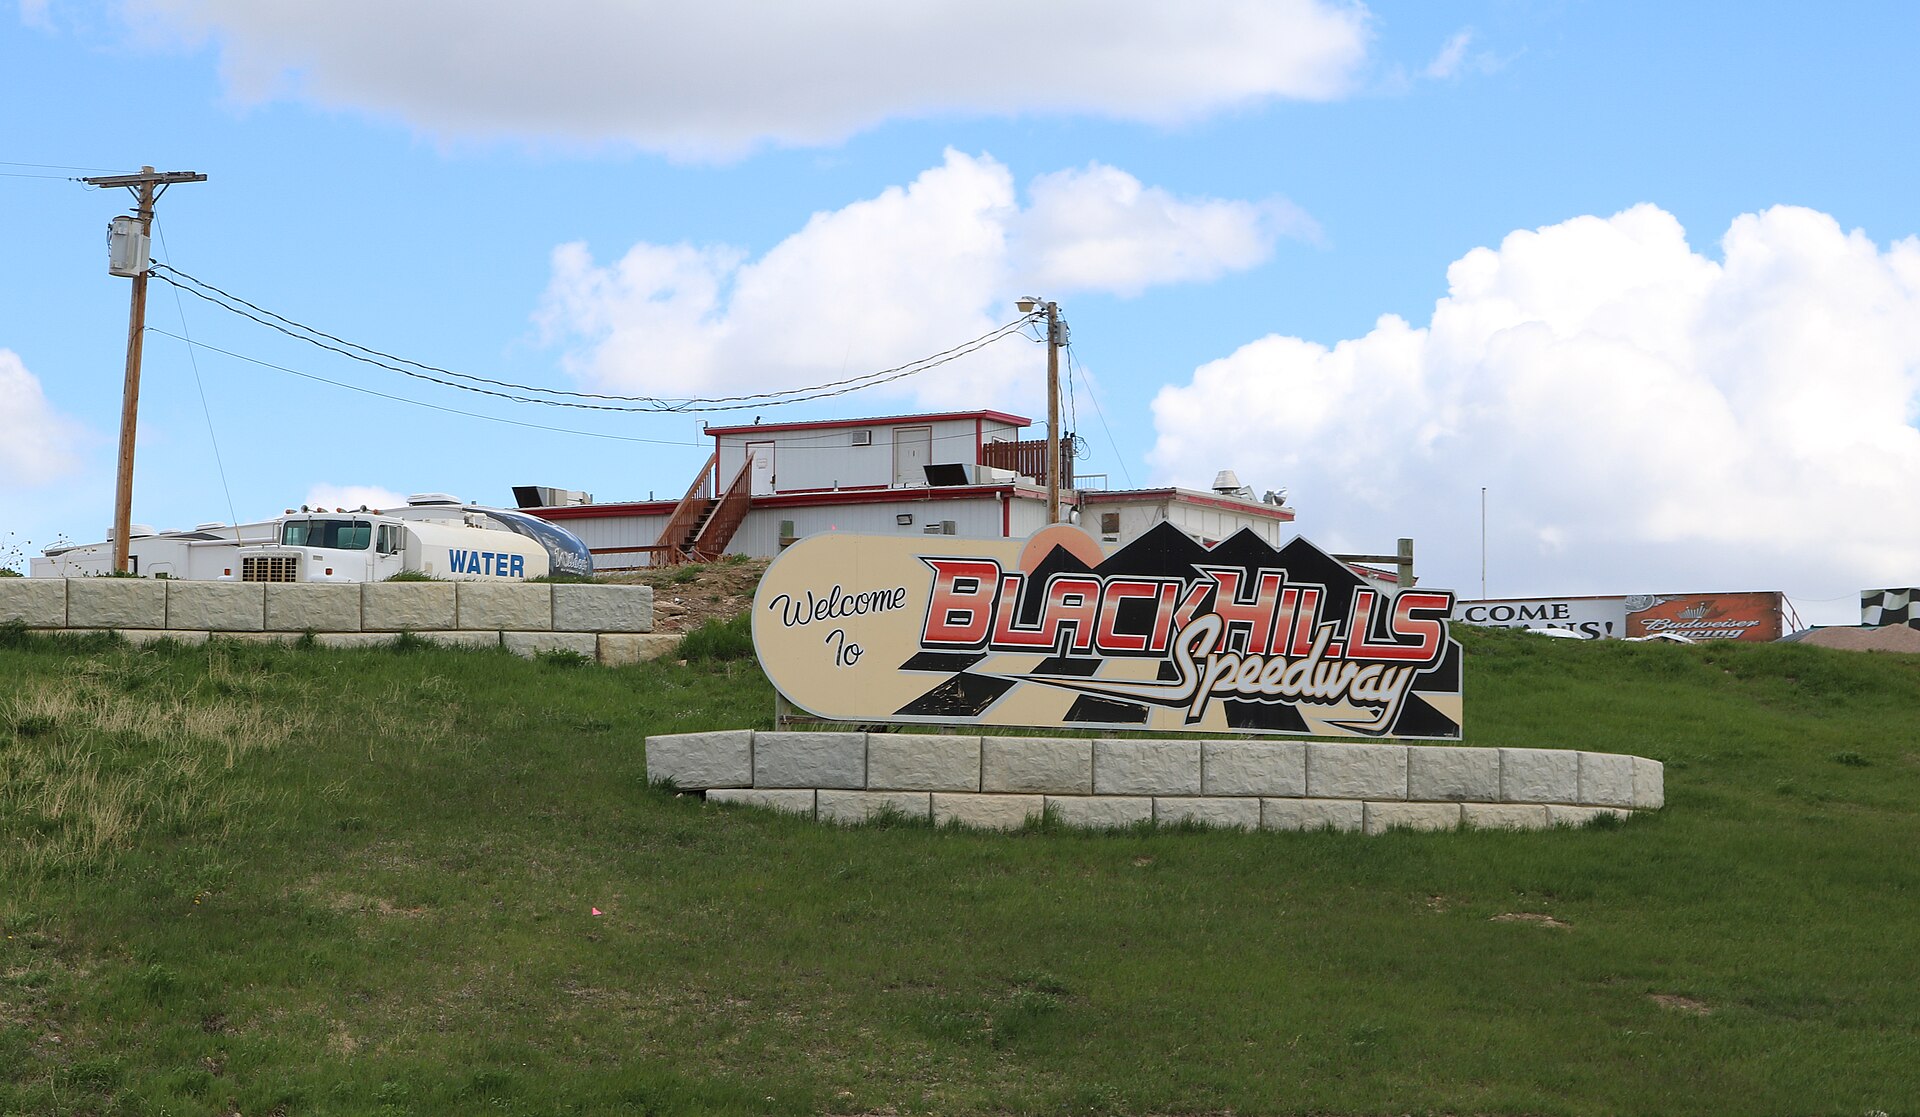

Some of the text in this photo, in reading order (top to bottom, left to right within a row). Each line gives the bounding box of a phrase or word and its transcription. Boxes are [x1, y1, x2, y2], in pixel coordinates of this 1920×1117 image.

[448, 549, 525, 578] WATER
[768, 584, 907, 627] Welcome
[1457, 603, 1570, 622] COME
[1640, 618, 1760, 631] Budweiser
[825, 629, 864, 667] To
[1140, 612, 1414, 731] Speedway
